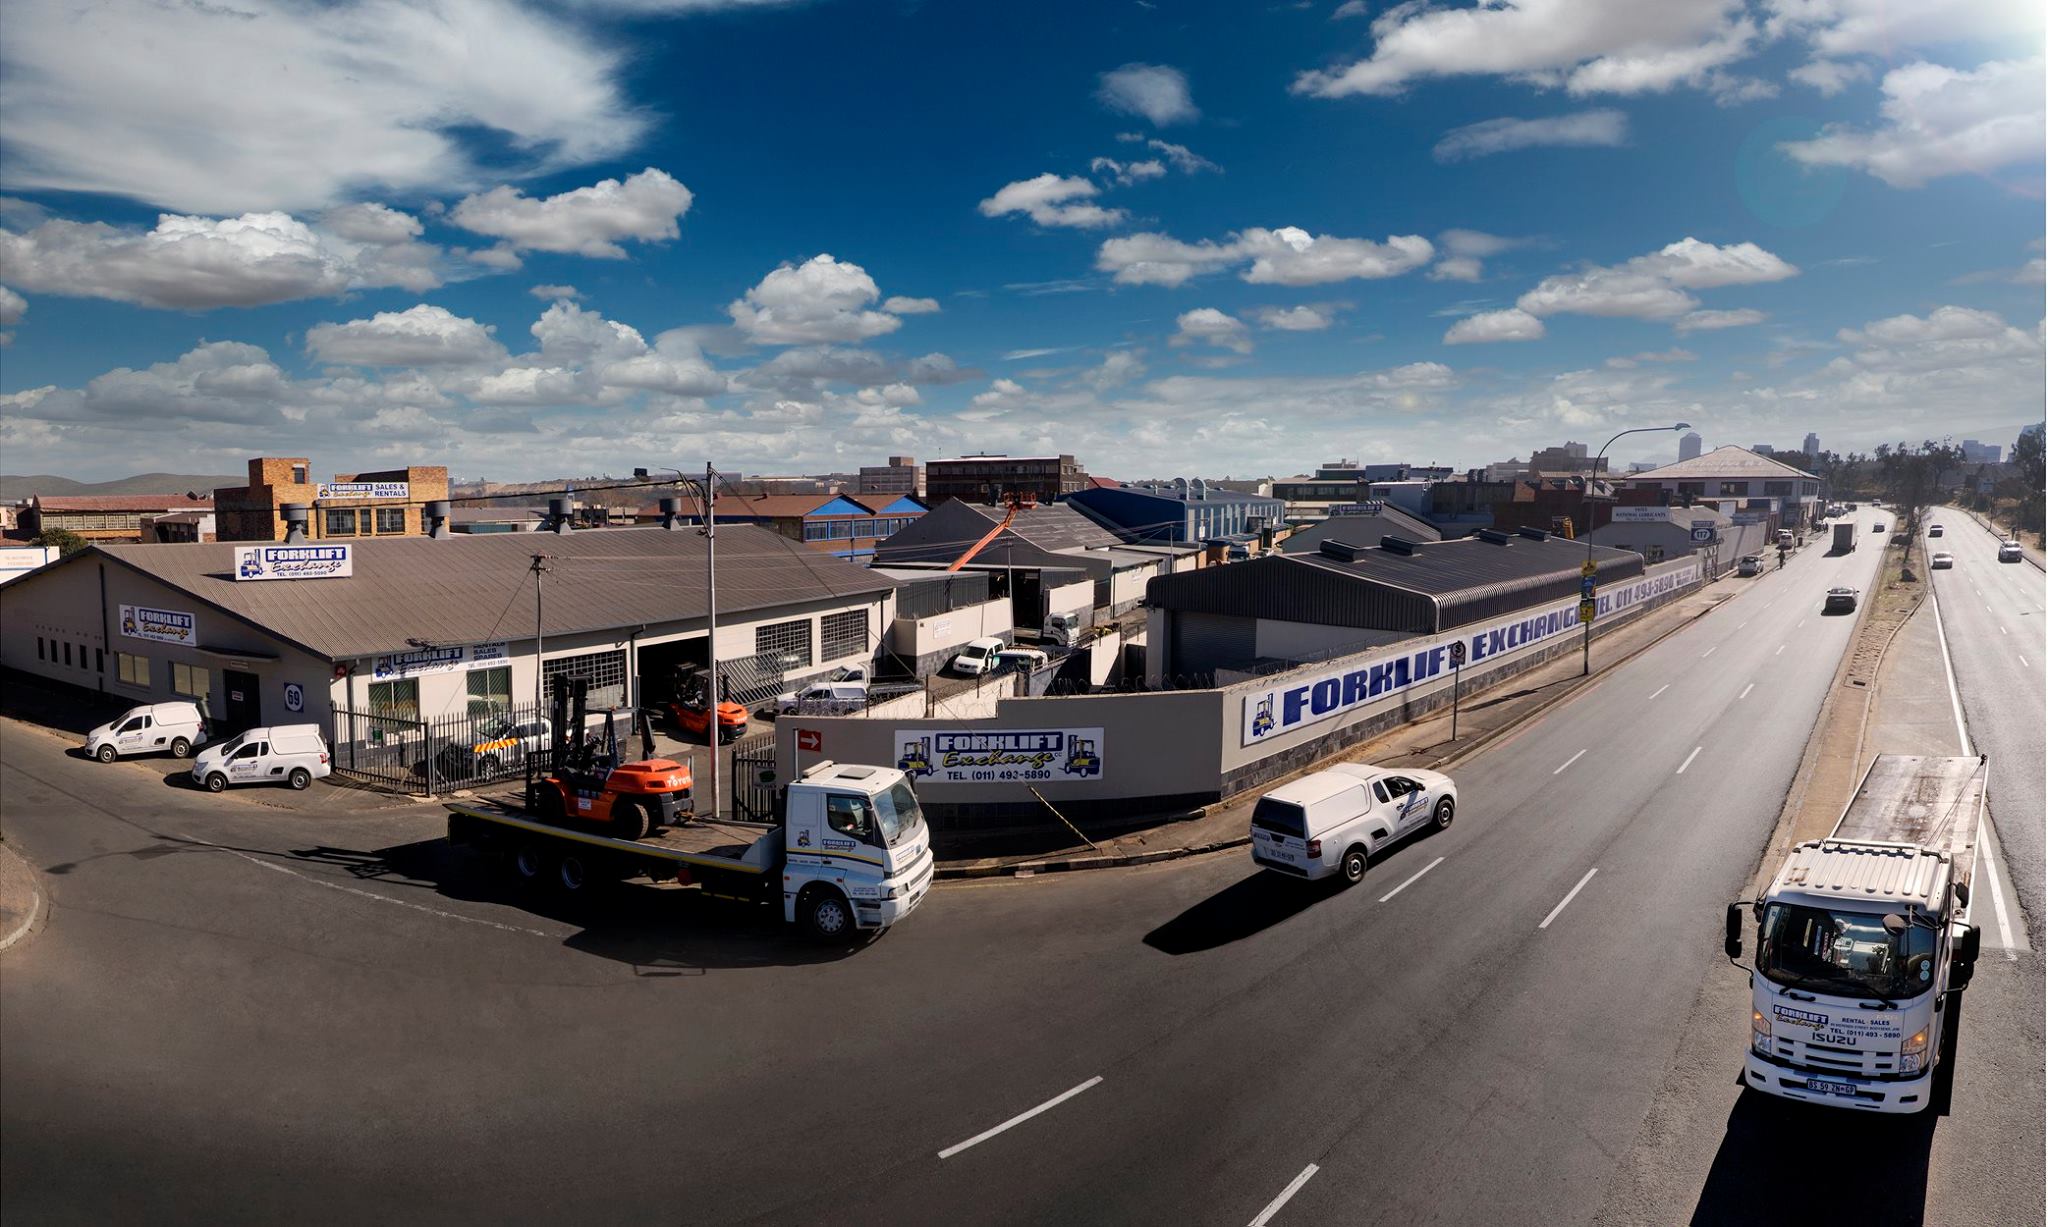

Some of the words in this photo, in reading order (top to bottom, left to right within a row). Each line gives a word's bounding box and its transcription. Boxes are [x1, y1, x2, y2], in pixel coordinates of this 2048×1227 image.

[267, 549, 344, 561] FORKLIFT
[1616, 588, 1633, 609] 011
[1634, 574, 1674, 600] 493-5890
[140, 611, 189, 627] FORKLIFT
[396, 648, 461, 665] FORKLIFT
[474, 647, 497, 656] SALES
[287, 689, 300, 706] 69
[939, 734, 1060, 750] FORKLIFT
[942, 750, 1055, 769] Exchange
[947, 771, 967, 780] TEL.
[972, 770, 995, 780] (011)
[999, 769, 1050, 780] 493-5890
[1774, 1006, 1828, 1024] FORKLIFT
[1842, 1017, 1865, 1025] RENTAL
[1812, 1032, 1856, 1046] ISUZU
